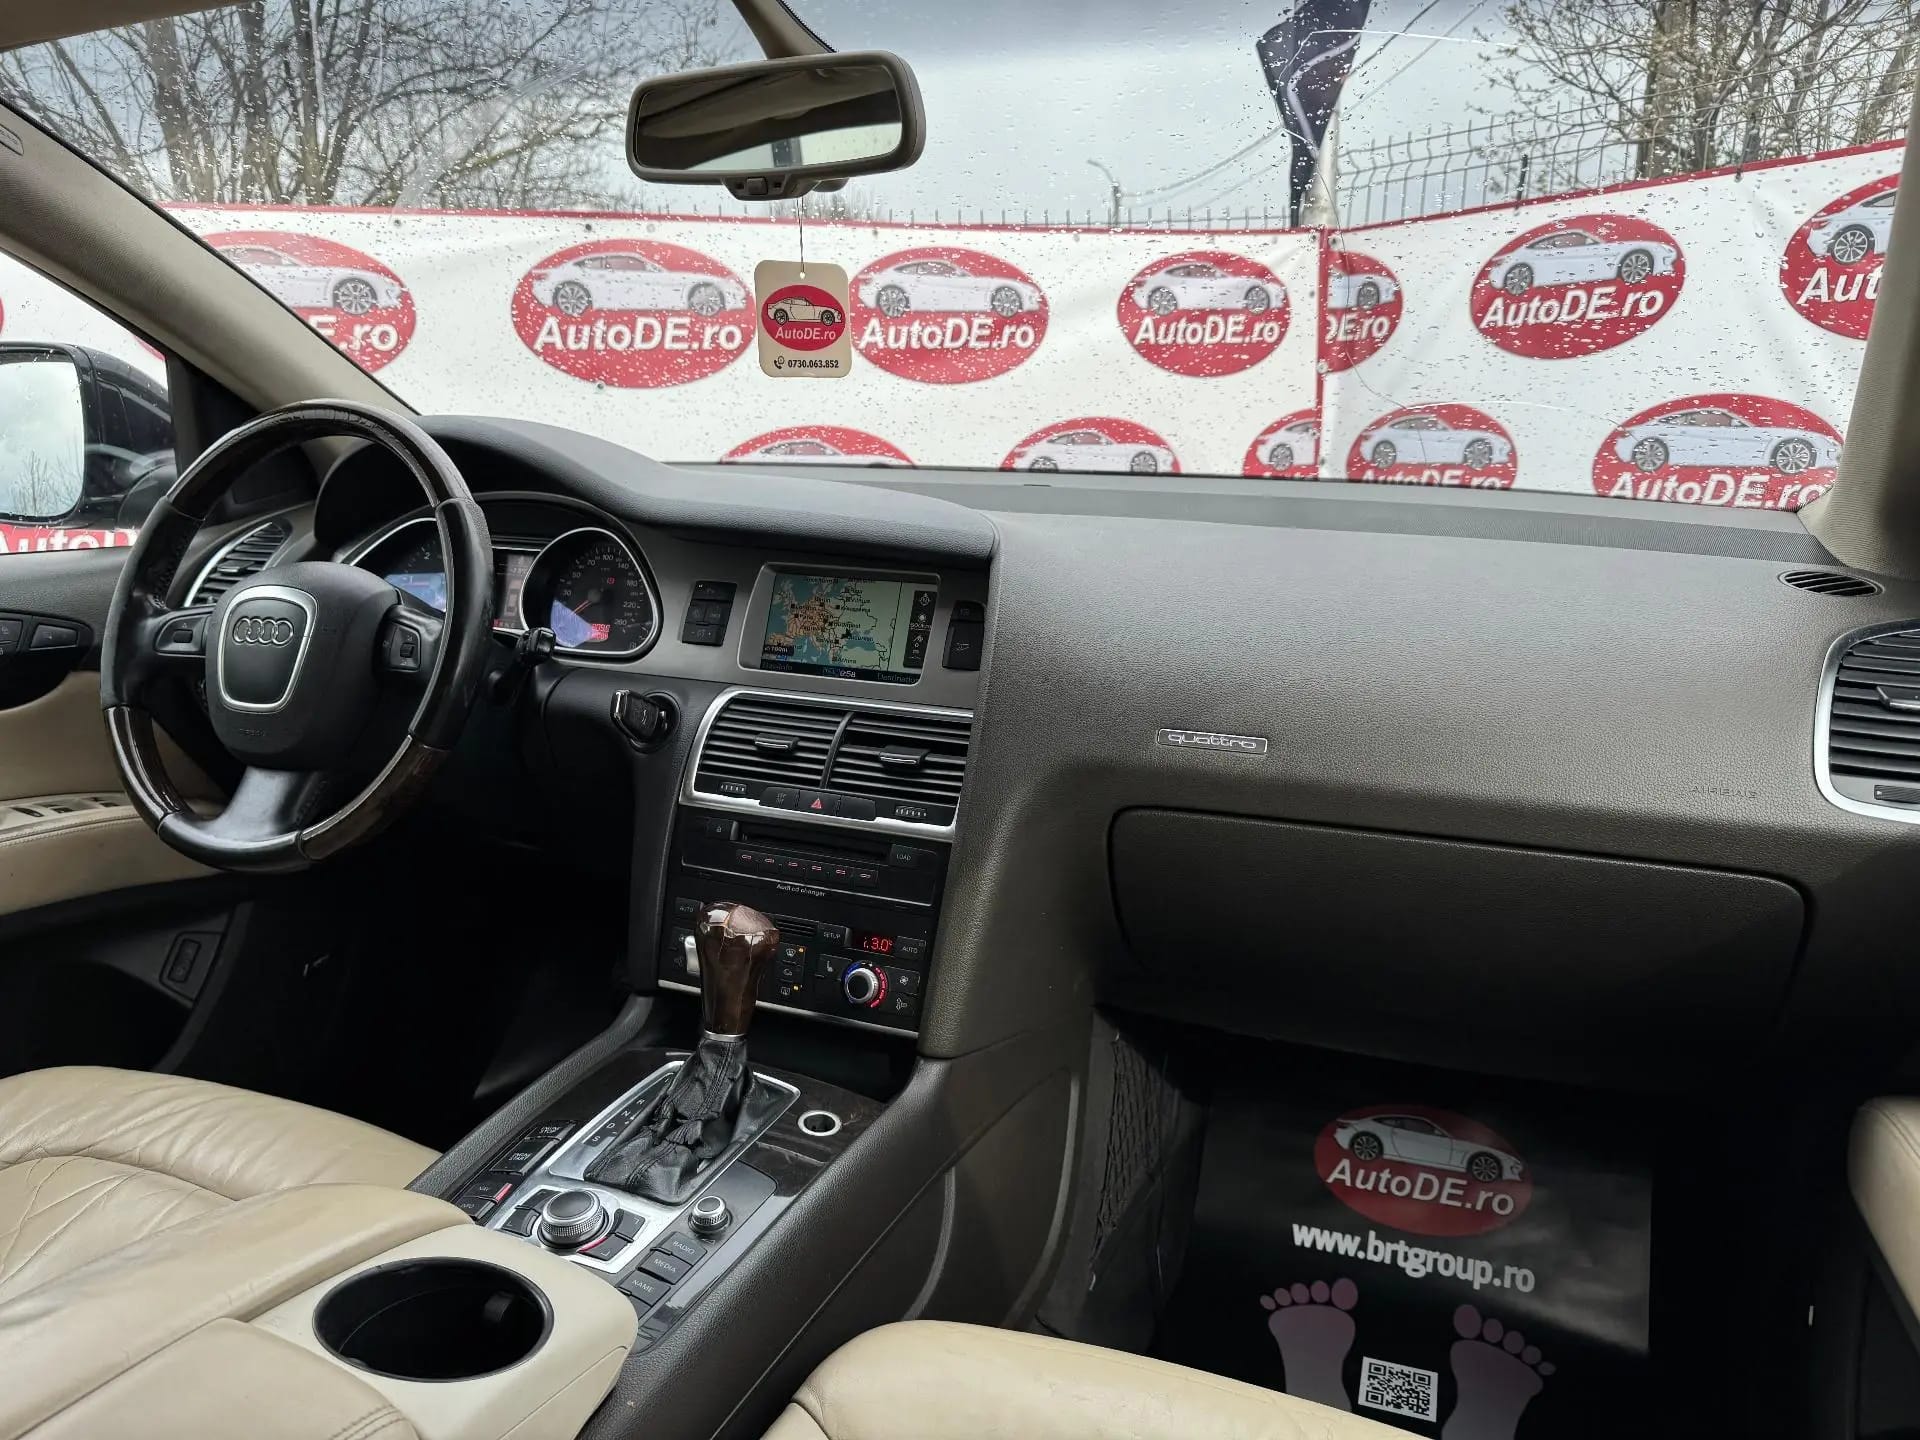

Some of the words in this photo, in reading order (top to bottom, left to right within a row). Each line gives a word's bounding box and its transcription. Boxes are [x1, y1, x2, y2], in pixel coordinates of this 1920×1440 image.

[1479, 287, 1664, 329] AutoDE.ro
[533, 316, 743, 351] AutoDE.ro
[775, 327, 836, 340] AutoDE.ro
[858, 317, 1036, 350] AutoDE.ro
[1134, 313, 1281, 345] AutoDE.ro
[788, 359, 839, 368] 0730.063.852
[1168, 734, 1257, 749] quattro
[592, 1135, 601, 1143] S
[1326, 1158, 1515, 1216] AutoDE.ro
[654, 1258, 676, 1273] MEDIA
[1292, 1223, 1536, 1293] www.brtgroup.ro
[632, 1279, 655, 1293] NAME
